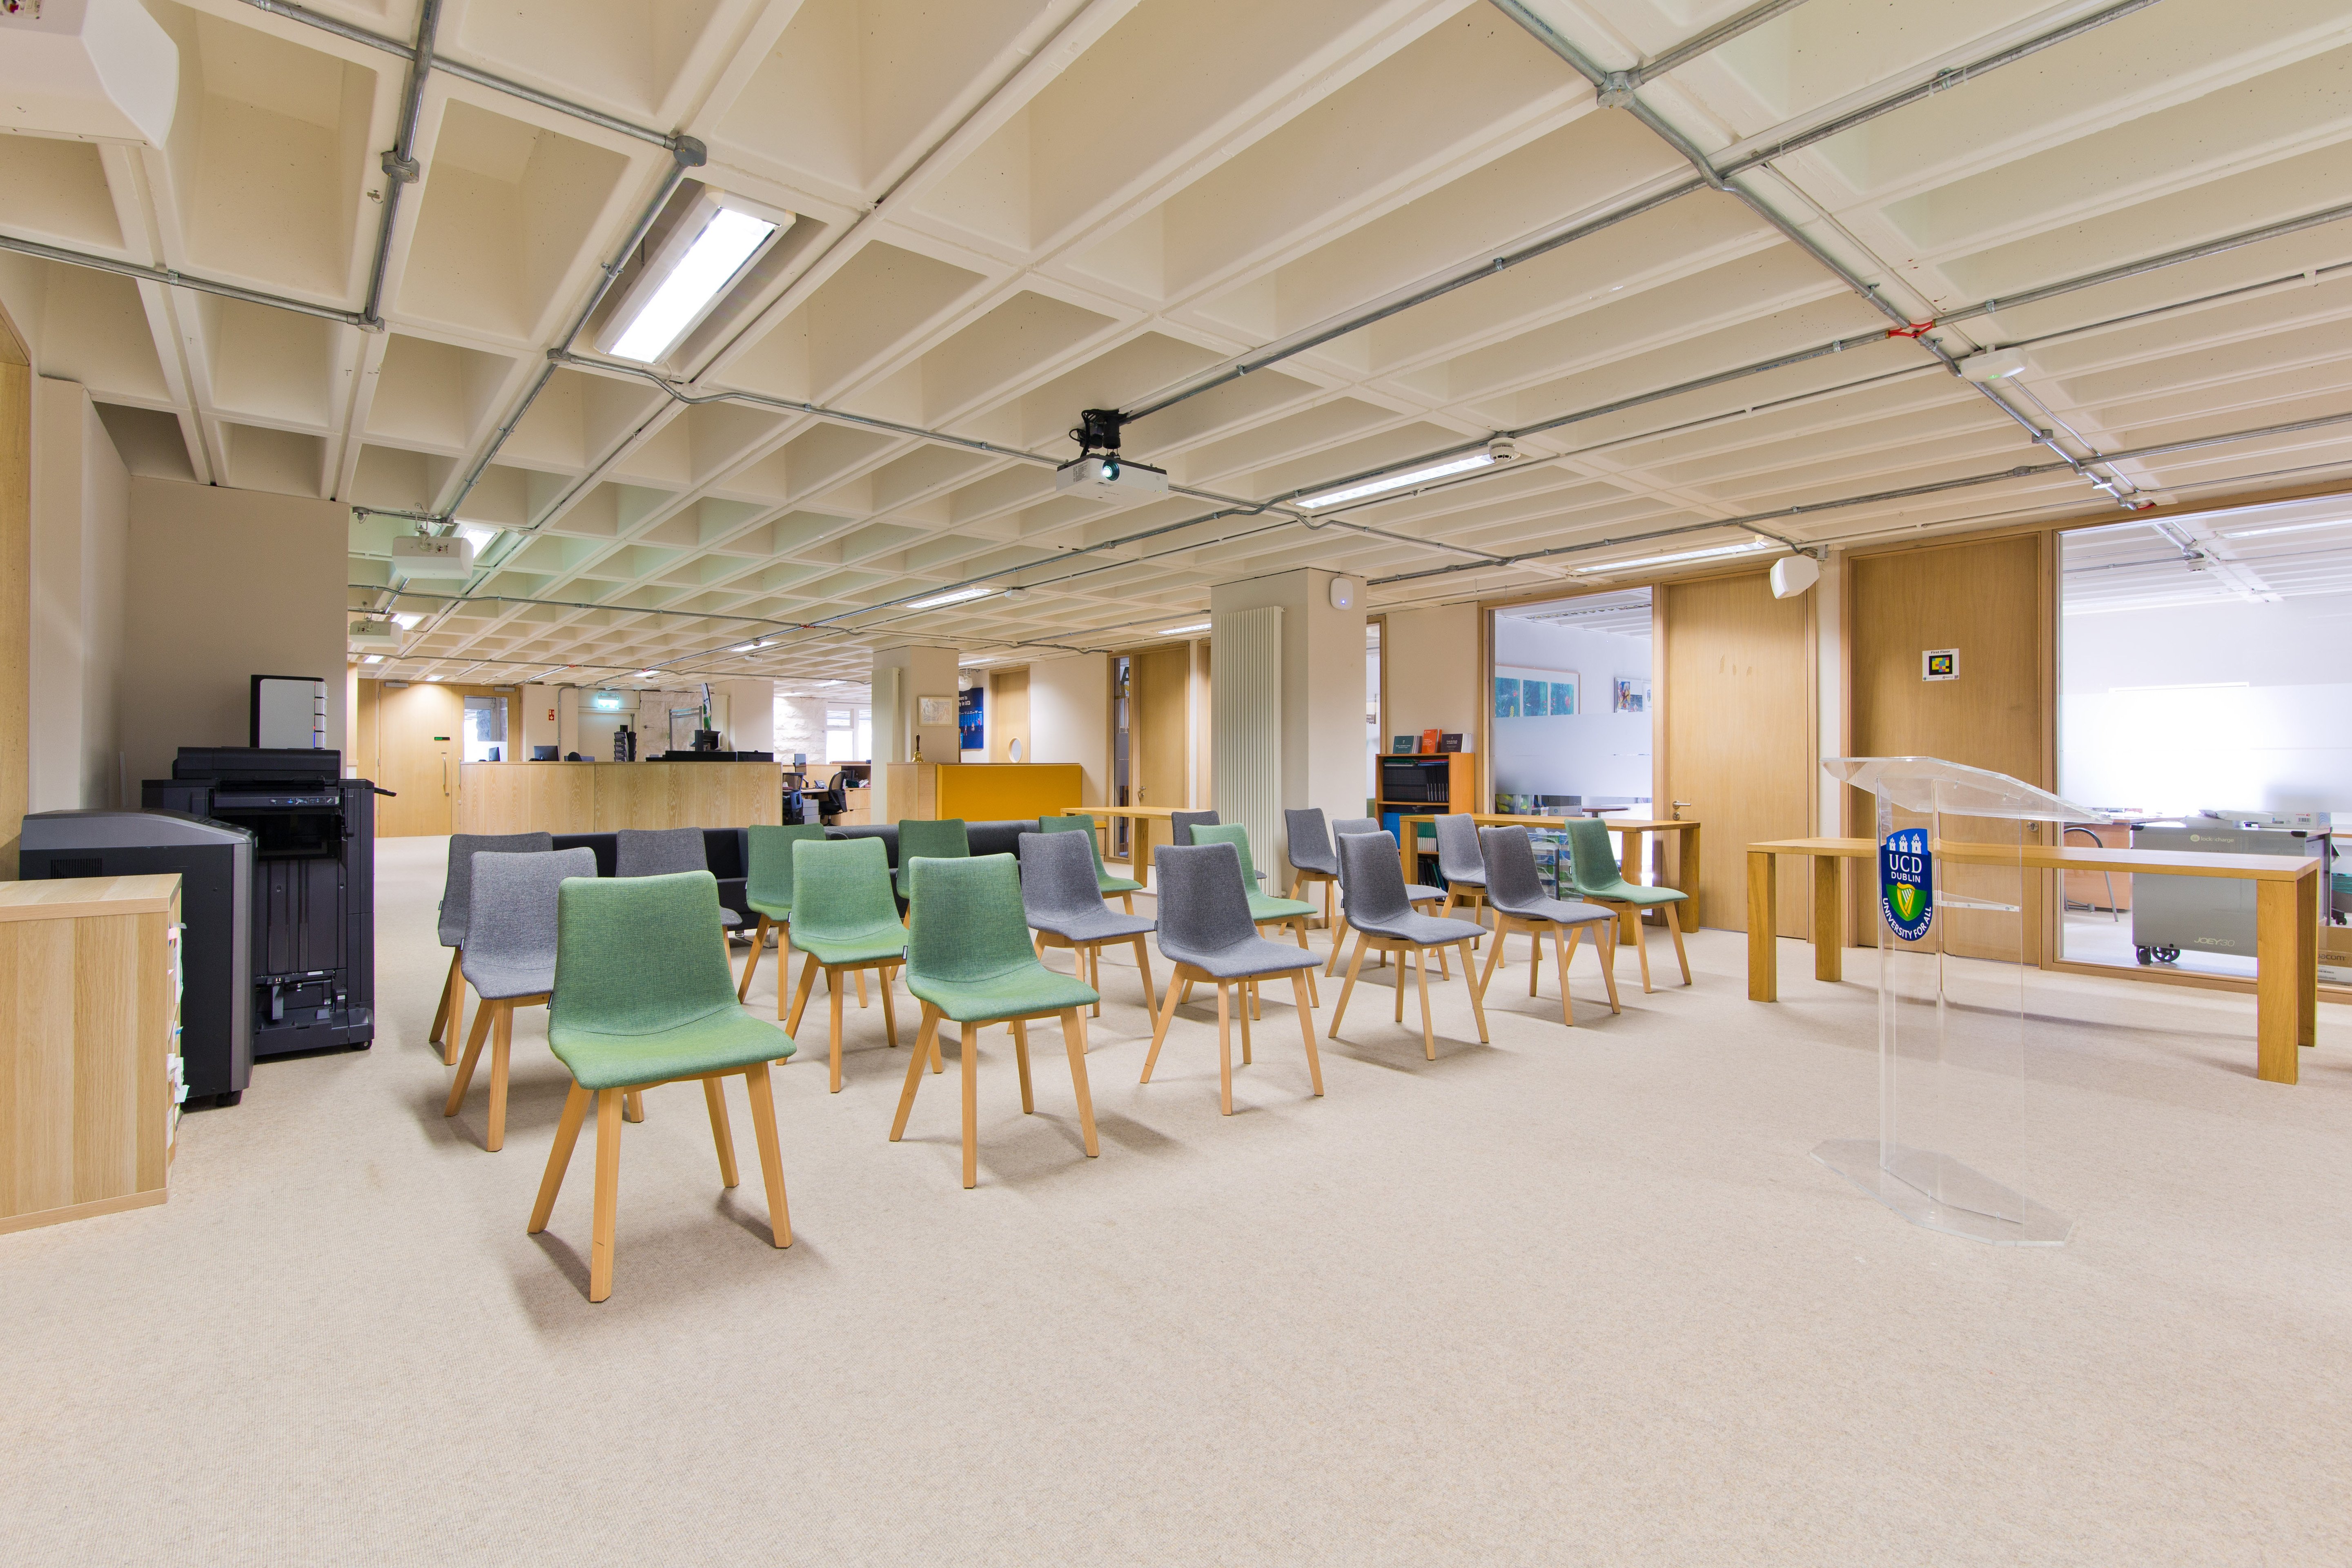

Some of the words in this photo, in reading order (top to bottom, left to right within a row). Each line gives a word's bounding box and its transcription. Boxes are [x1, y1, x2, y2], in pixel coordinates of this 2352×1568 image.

[1889, 853, 1922, 873] UCD
[1891, 871, 1920, 883] DUBLIN
[1883, 898, 1912, 939] UNIVERSITY
[1913, 922, 1927, 938] FOR
[1923, 906, 1931, 924] ALL
